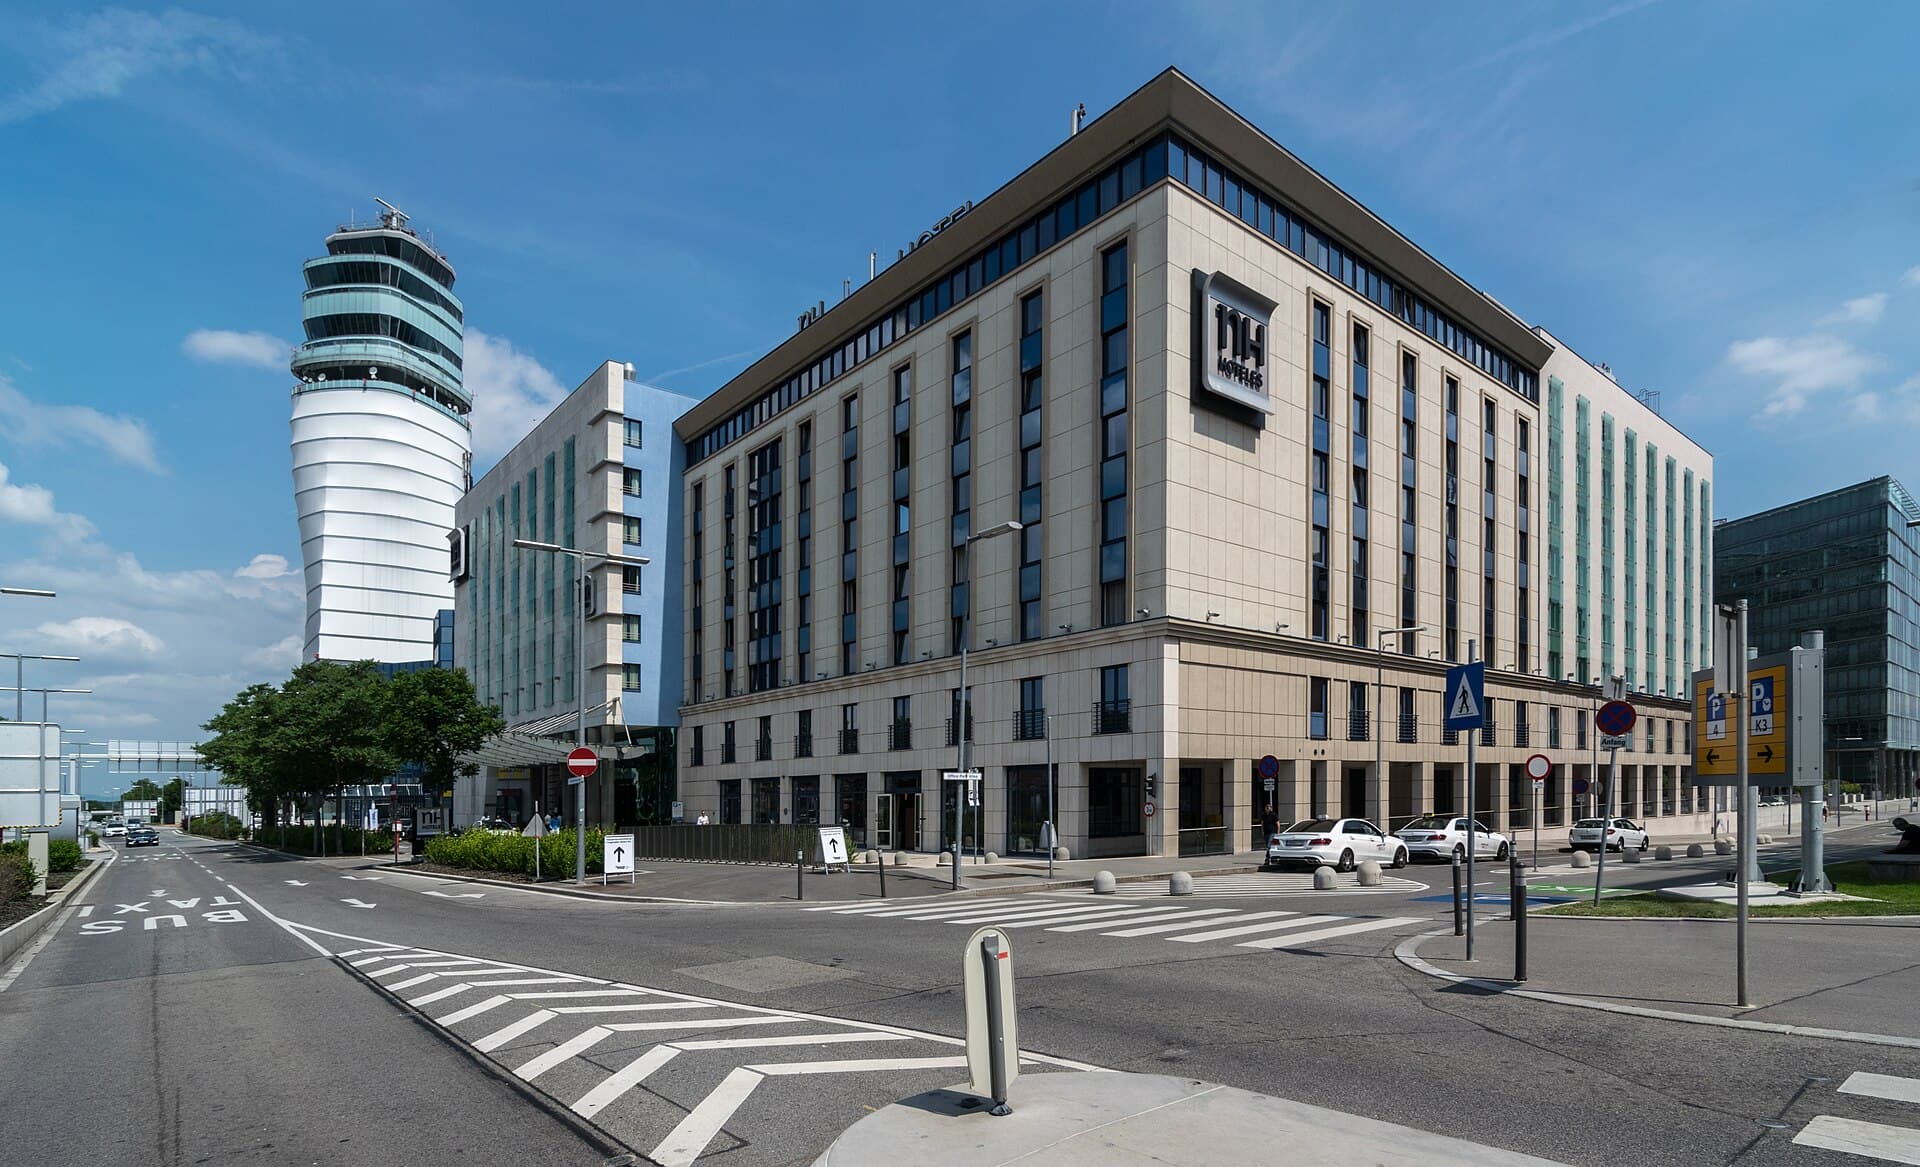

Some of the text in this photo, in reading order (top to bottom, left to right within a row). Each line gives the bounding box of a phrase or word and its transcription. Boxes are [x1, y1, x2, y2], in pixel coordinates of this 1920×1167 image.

[1217, 355, 1263, 390] HOTELES
[1712, 698, 1721, 719] P
[1752, 683, 1764, 713] P
[1713, 724, 1719, 736] 4
[1755, 719, 1768, 732] K3
[78, 896, 241, 917] TAXI
[79, 909, 248, 935] BUS
